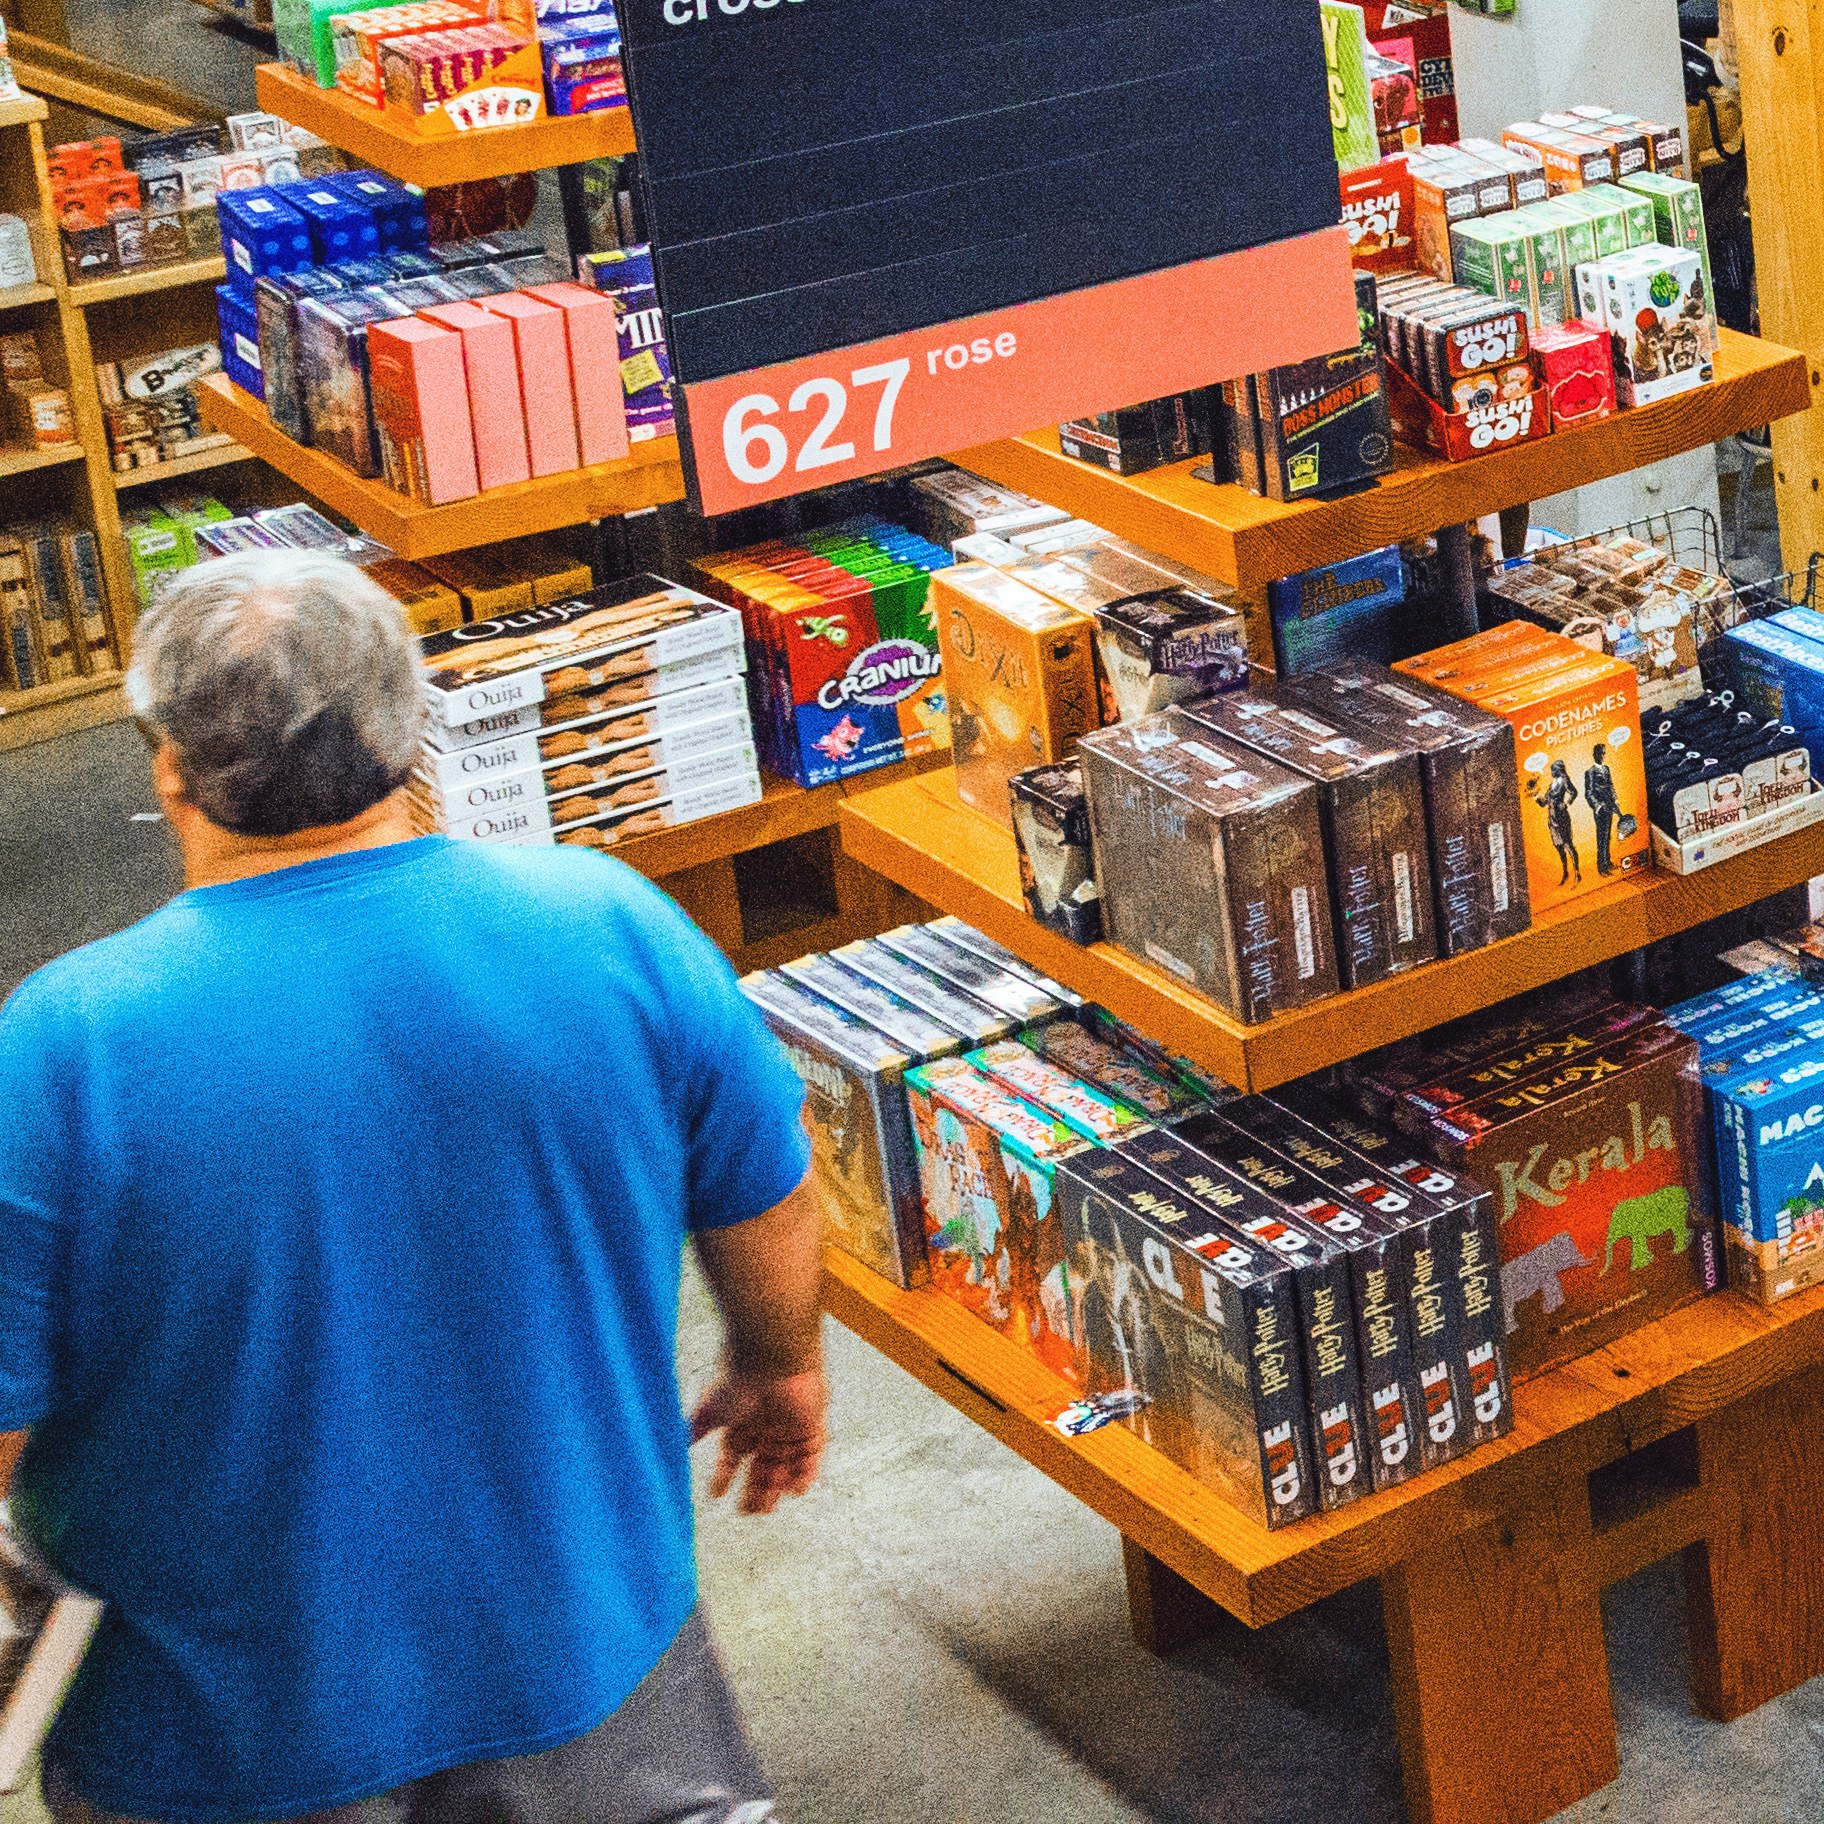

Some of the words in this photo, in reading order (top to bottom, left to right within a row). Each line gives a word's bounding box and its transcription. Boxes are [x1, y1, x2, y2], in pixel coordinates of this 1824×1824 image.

[1455, 312, 1518, 347] SUSHI
[1458, 334, 1516, 369] GO!
[722, 358, 911, 485] 627
[927, 330, 1017, 376] rose
[1466, 397, 1534, 430] SUSHI
[1469, 417, 1531, 450] GO!
[450, 594, 597, 645] Ouija
[467, 680, 524, 713] Ouija
[1518, 688, 1629, 748] CODENAMES
[461, 744, 518, 775] Ouija
[467, 777, 524, 809] Ouija
[1494, 1100, 1677, 1223] Kerala
[1702, 1229, 1716, 1290] KOSMOS
[1322, 1400, 1356, 1486] CLUE
[1374, 1381, 1408, 1465] CLUE
[1272, 1419, 1300, 1507] CLUE
